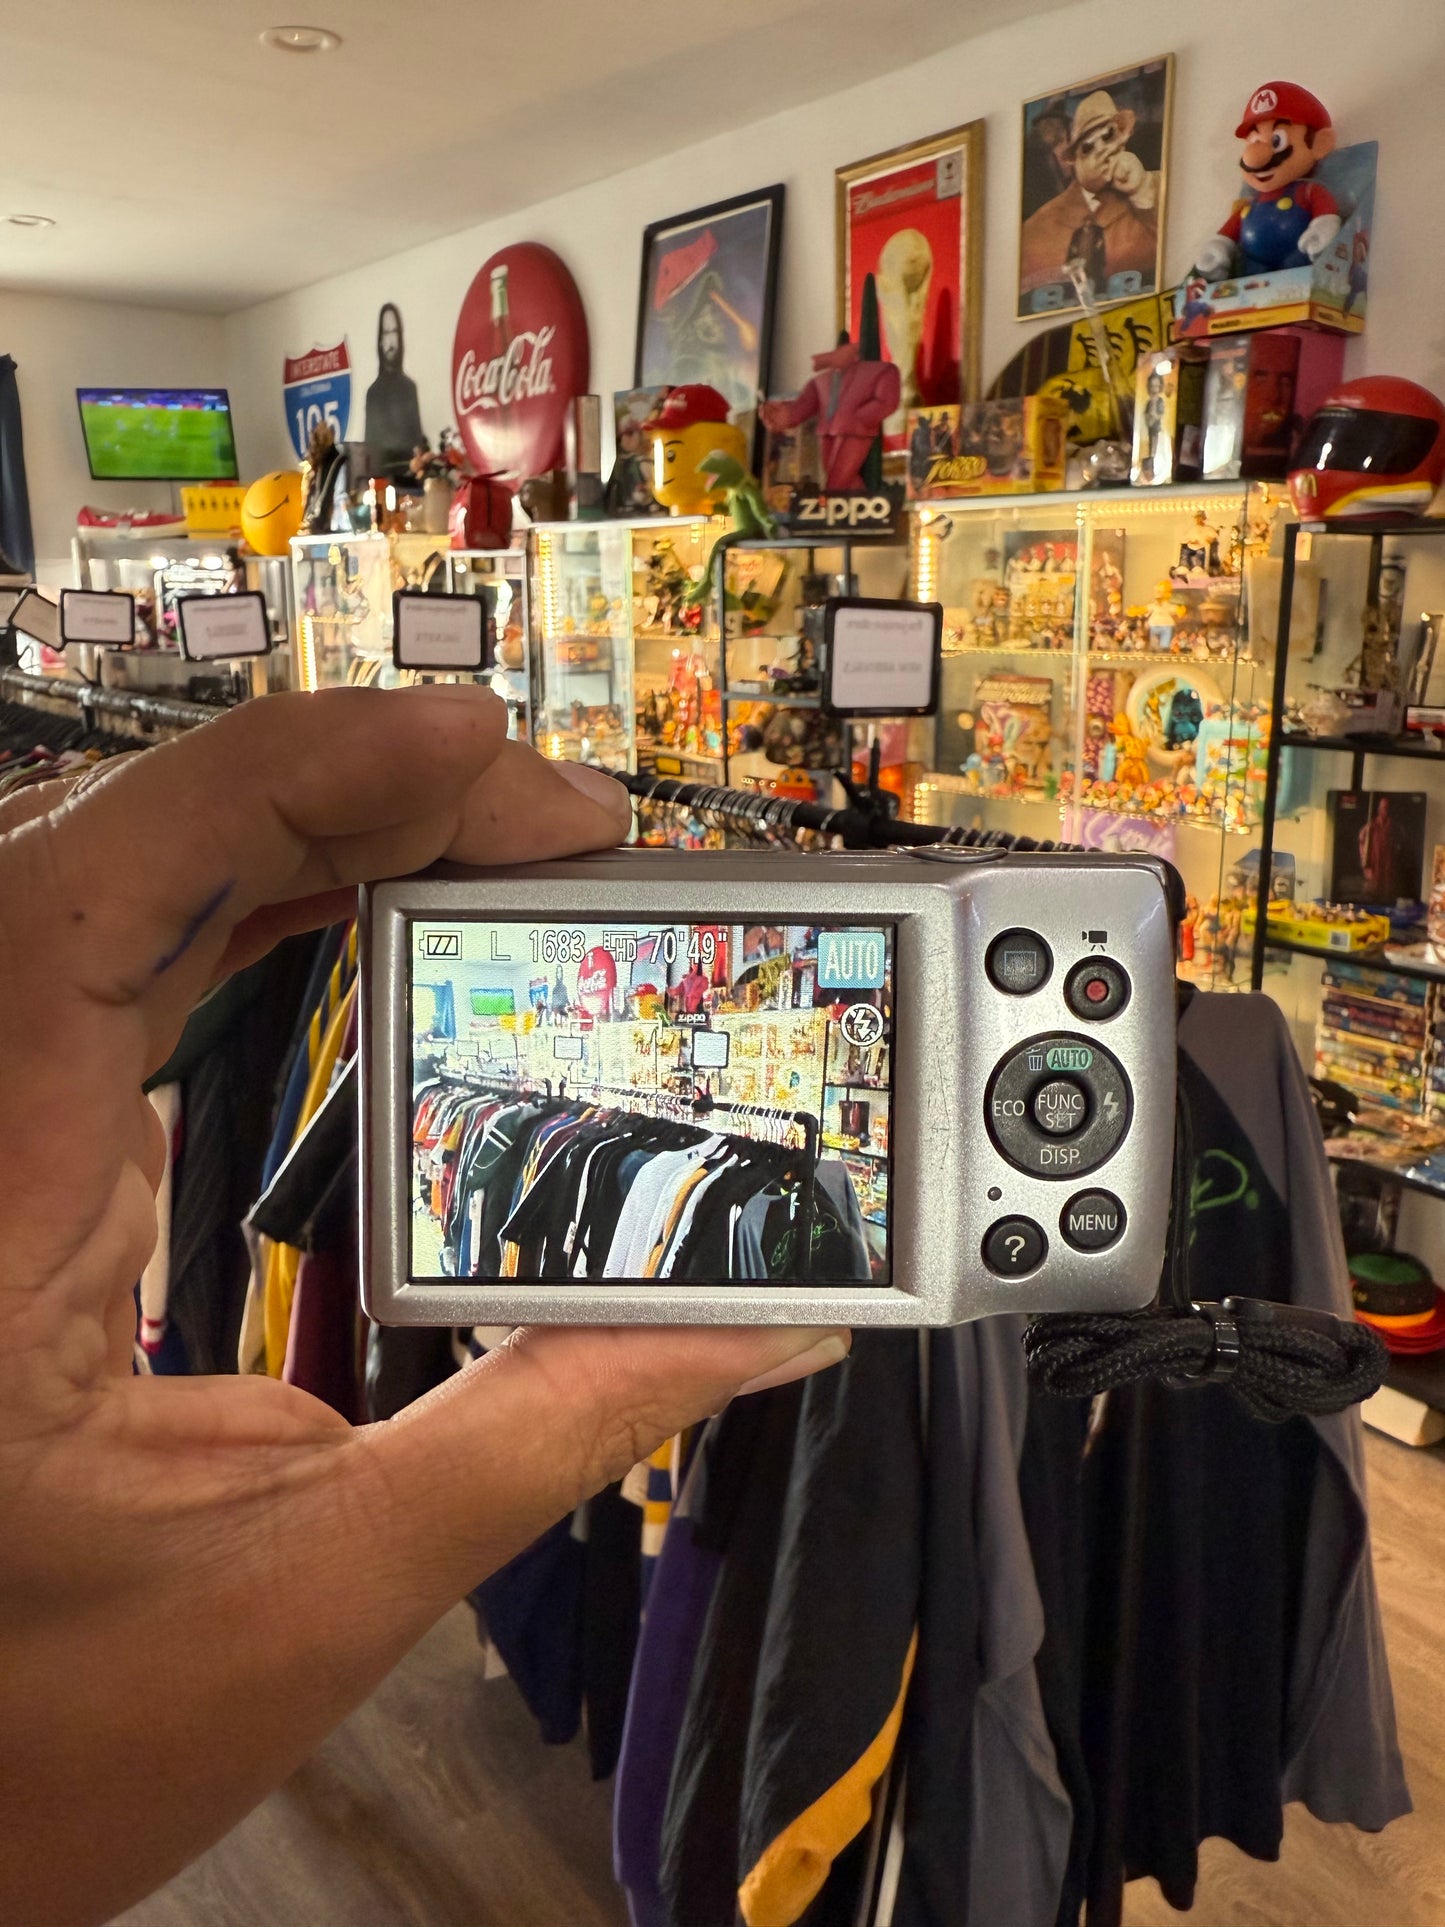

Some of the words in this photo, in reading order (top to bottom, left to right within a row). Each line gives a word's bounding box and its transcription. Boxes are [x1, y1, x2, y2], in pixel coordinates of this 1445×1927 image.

[529, 929, 586, 964] 1683
[824, 940, 880, 981] AUTO
[1050, 1049, 1089, 1068] AUTO
[994, 1100, 1025, 1117] ECO
[1045, 1112, 1077, 1129] SET
[1069, 1213, 1119, 1231] MENU
